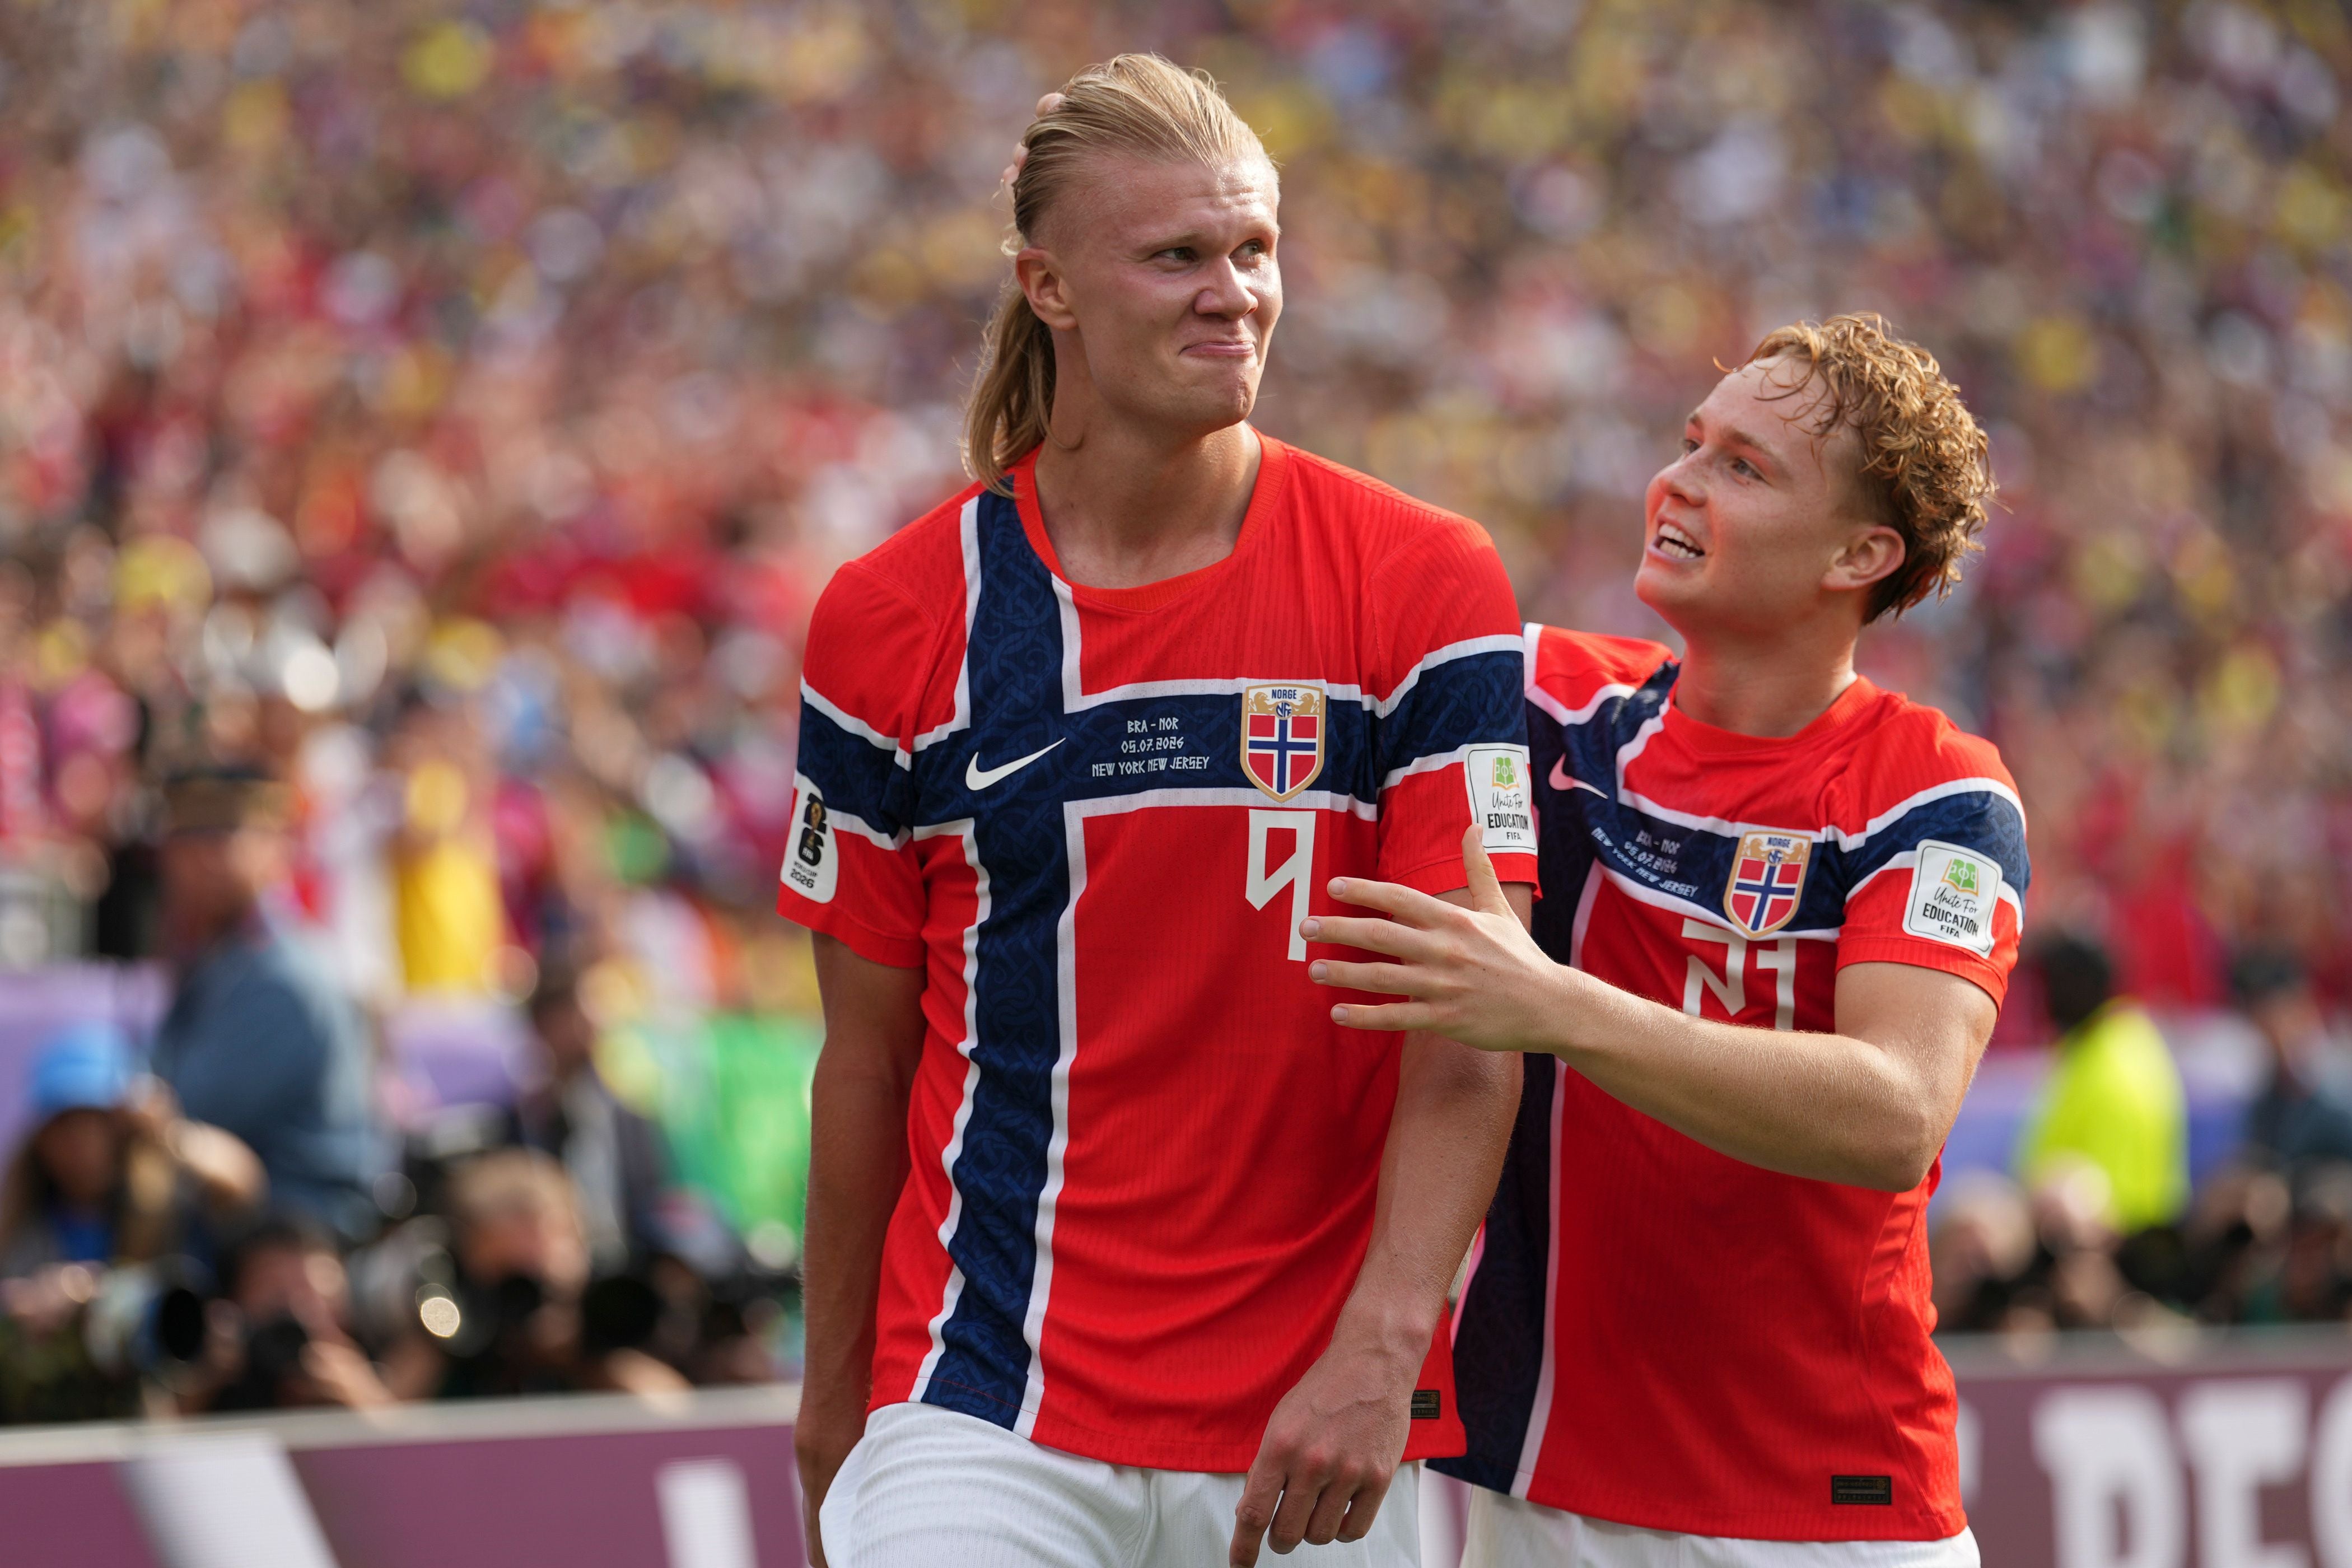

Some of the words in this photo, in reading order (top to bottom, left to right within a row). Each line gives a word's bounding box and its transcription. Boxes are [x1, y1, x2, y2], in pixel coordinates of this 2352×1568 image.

[1271, 689, 1297, 699] NORGE
[1127, 720, 1148, 733] BRA
[1159, 717, 1179, 730] NOR
[1121, 736, 1184, 753] 05.07.2026
[1092, 763, 1116, 777] NEW
[1118, 760, 1145, 775] YORK
[1147, 757, 1168, 772] NEW
[1169, 756, 1210, 769] JERSEY
[1492, 791, 1513, 810] Unite
[1487, 813, 1529, 830] EDUCATION
[1506, 832, 1522, 840] FIFA
[1591, 827, 1614, 847] NEW
[1635, 867, 1661, 883] NEW
[1658, 879, 1700, 898] JERSEY
[791, 868, 815, 888] 2026
[1245, 809, 1316, 962] 9
[1934, 886, 1962, 909] Unite
[1963, 899, 1980, 914] For
[1922, 902, 1979, 937] EDUCATION
[1940, 925, 1960, 939] FIFA
[1681, 918, 1797, 1032] 21
